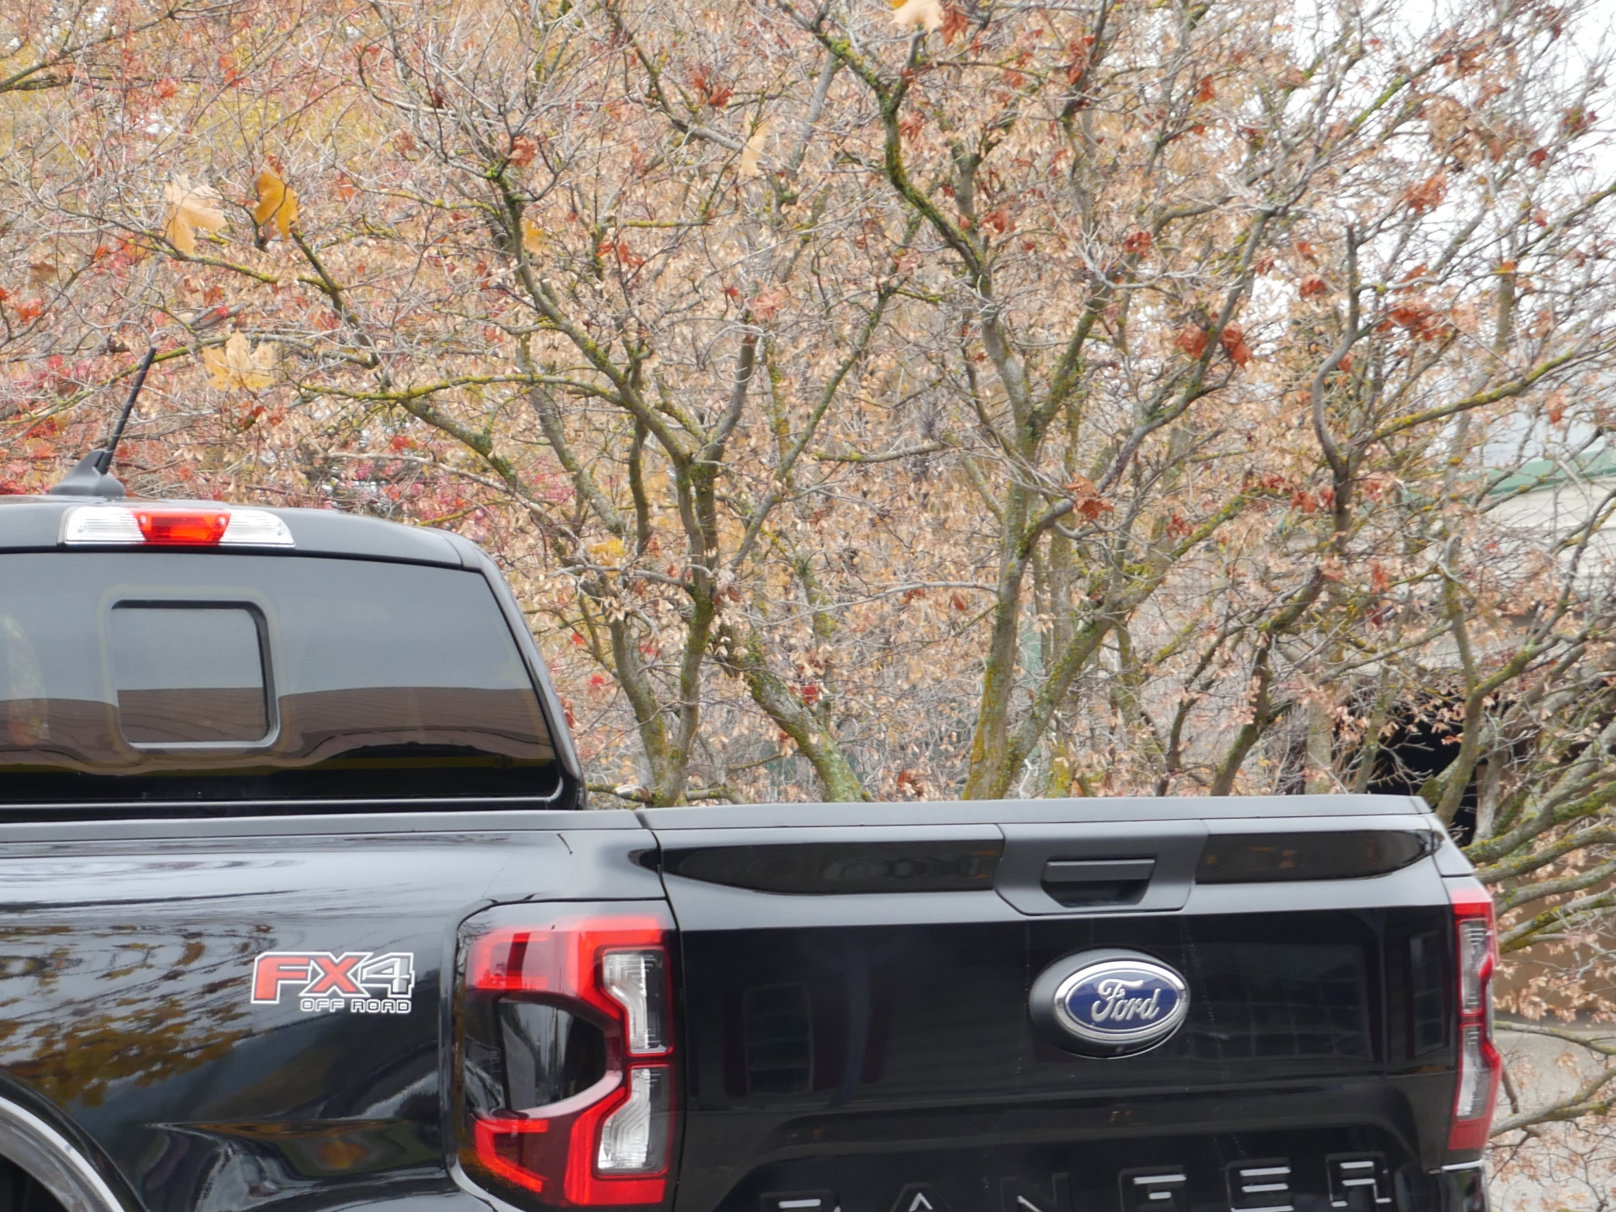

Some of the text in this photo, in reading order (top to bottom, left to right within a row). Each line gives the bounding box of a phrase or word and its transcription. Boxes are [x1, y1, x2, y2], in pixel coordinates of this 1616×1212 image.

[250, 951, 416, 1004] FX4
[1090, 977, 1161, 1023] Ford
[300, 998, 412, 1014] OFF ROAD
